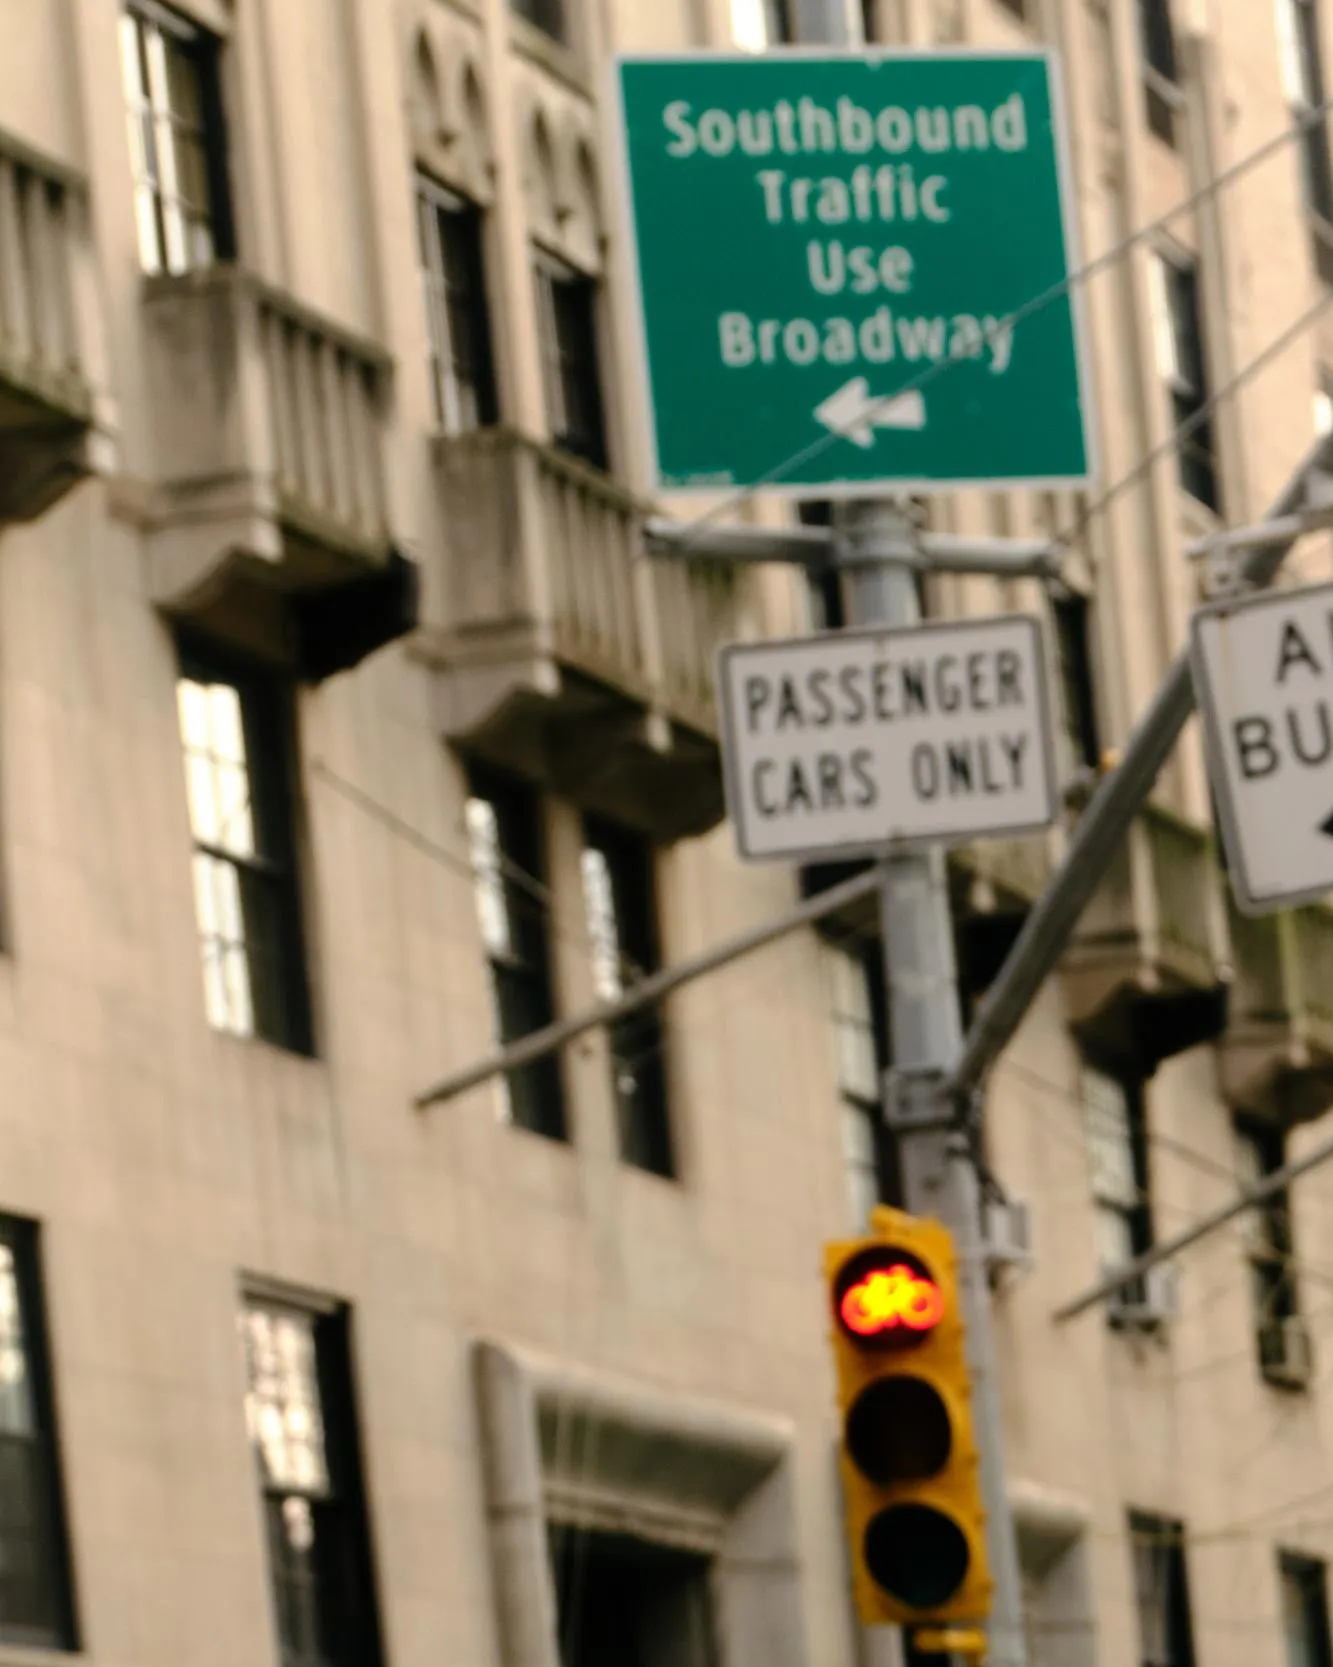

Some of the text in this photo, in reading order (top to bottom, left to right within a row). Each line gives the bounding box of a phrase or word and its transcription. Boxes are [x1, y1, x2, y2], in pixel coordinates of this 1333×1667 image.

[663, 92, 1028, 158] Southbound
[756, 162, 950, 224] Traffic
[807, 239, 914, 295] Use
[717, 305, 1015, 374] Broadway
[745, 648, 1026, 733] PASSENGER
[752, 732, 1027, 820] CARS ONLY
